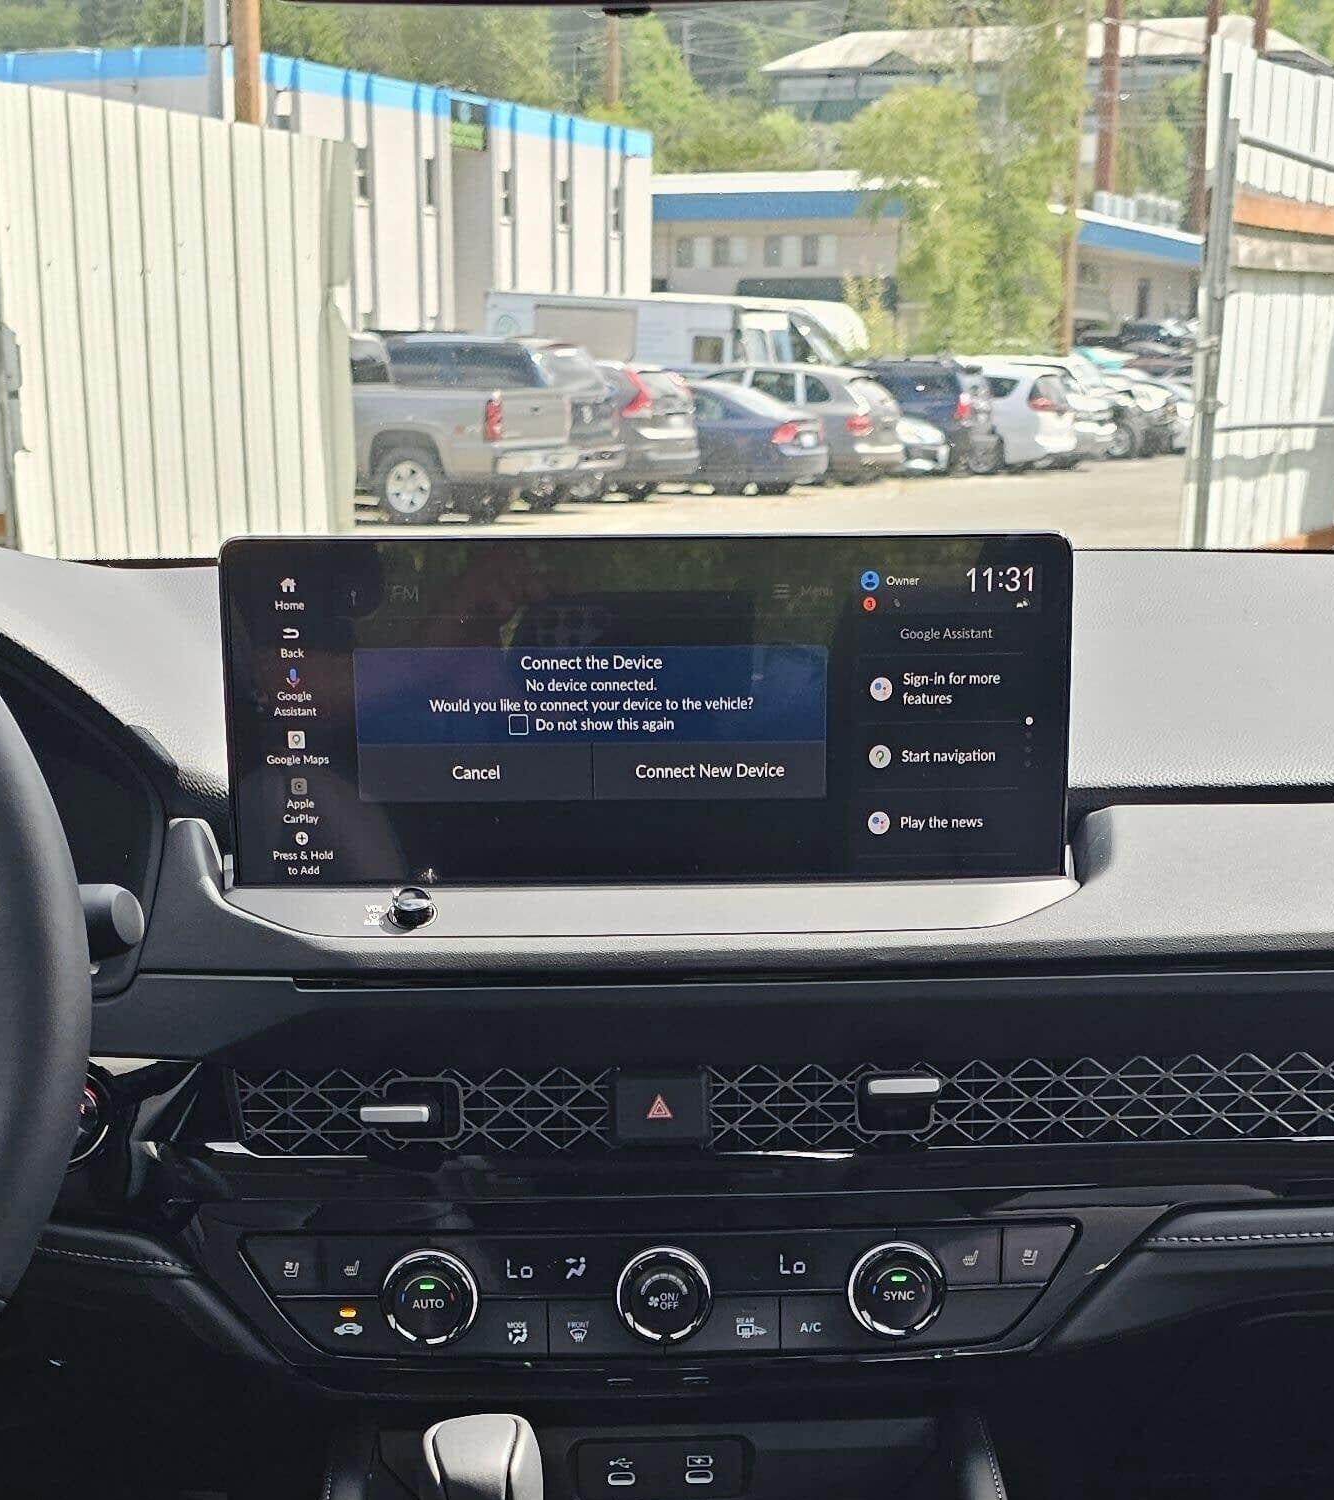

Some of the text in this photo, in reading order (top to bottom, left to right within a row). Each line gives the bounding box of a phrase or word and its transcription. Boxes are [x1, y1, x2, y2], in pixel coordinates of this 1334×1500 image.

[886, 576, 919, 586] Owner
[966, 566, 1034, 593] 11:31
[275, 601, 304, 611] Home
[900, 628, 993, 641] Google Assistant
[281, 649, 304, 658] Back
[521, 655, 663, 670] Connect the Device
[526, 678, 657, 692] No device connected.
[903, 672, 1001, 687] Sign-in for more
[277, 692, 312, 702] Google
[903, 692, 953, 705] features
[274, 707, 317, 717] Assistant
[429, 697, 754, 714] Would you like to connect your device to the vehicle?
[536, 718, 674, 732] Do not show this again
[267, 755, 329, 765] Google Maps
[902, 749, 996, 764] Start navigation
[452, 765, 500, 780] Cancel
[636, 763, 785, 779] Connect New Device
[287, 800, 314, 810] Apple
[283, 814, 319, 825] CarPlay
[900, 816, 984, 831] Play the news
[273, 851, 333, 861] Press & Hold
[288, 866, 319, 875] to Add
[506, 1258, 533, 1280] Lo
[779, 1254, 806, 1275] Lo
[660, 1293, 679, 1301] ON/
[882, 1289, 916, 1302] SYNC
[412, 1298, 444, 1309] AUTO
[660, 1302, 679, 1310] OFF
[800, 1322, 821, 1332] A/C
